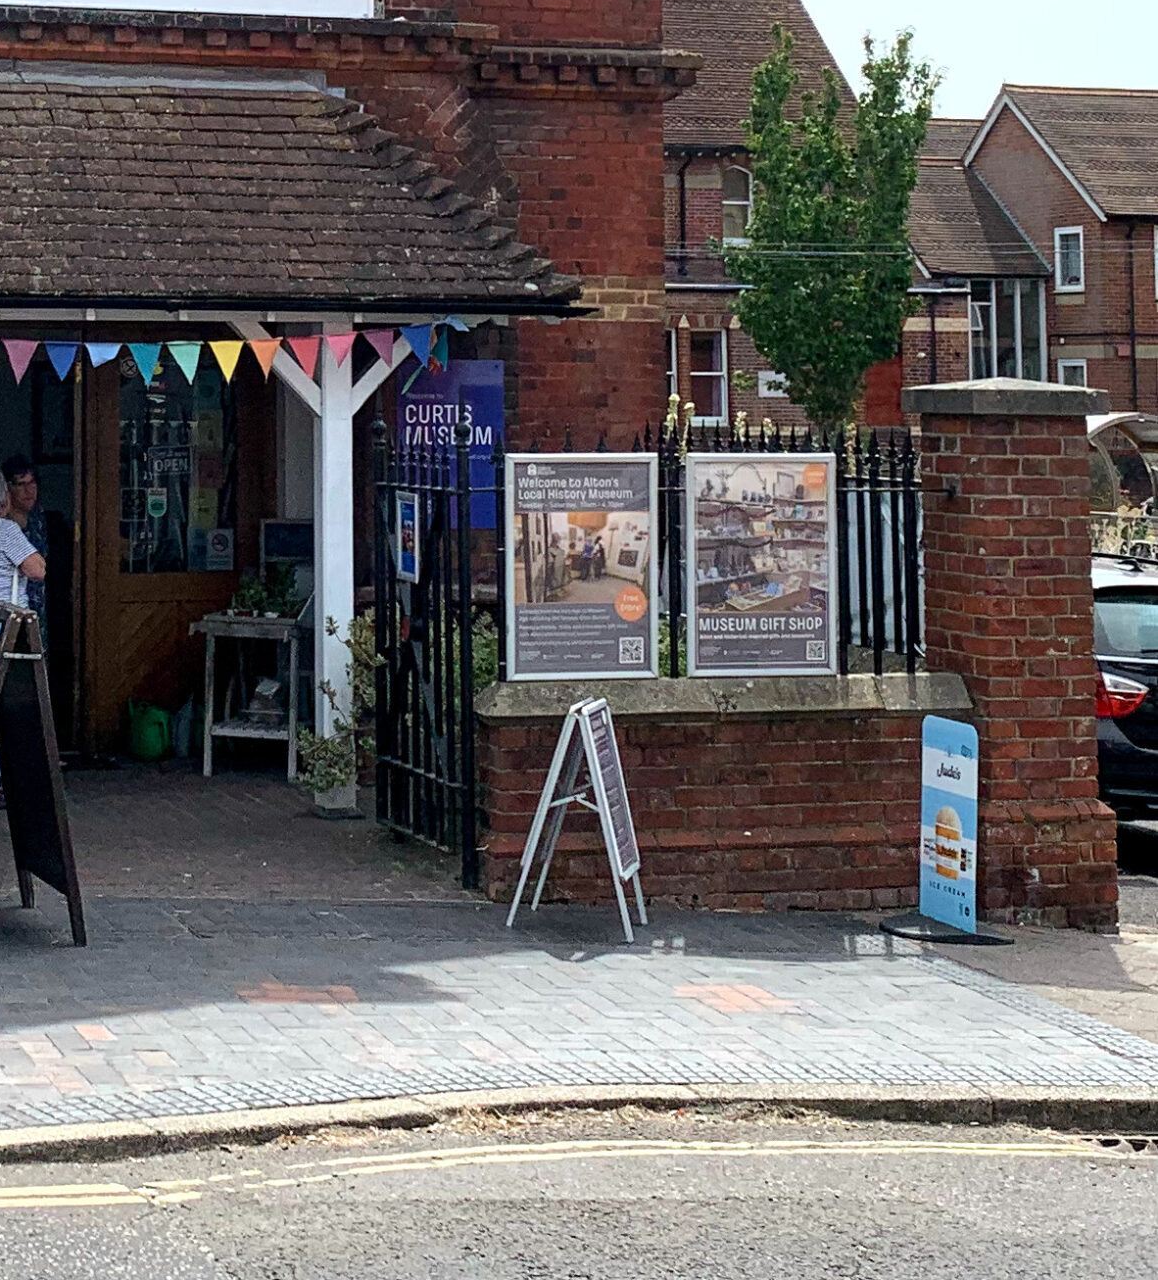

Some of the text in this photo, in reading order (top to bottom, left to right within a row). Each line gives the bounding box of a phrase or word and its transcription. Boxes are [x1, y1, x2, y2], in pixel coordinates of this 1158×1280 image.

[405, 404, 473, 424] CURTIS
[154, 459, 188, 472] OPEN
[517, 476, 619, 488] Welcome to Alton's
[517, 488, 634, 501] Local History Museum
[698, 616, 823, 631] MUSEUM GIFT SHOP
[929, 880, 966, 899] ICE CREAM
